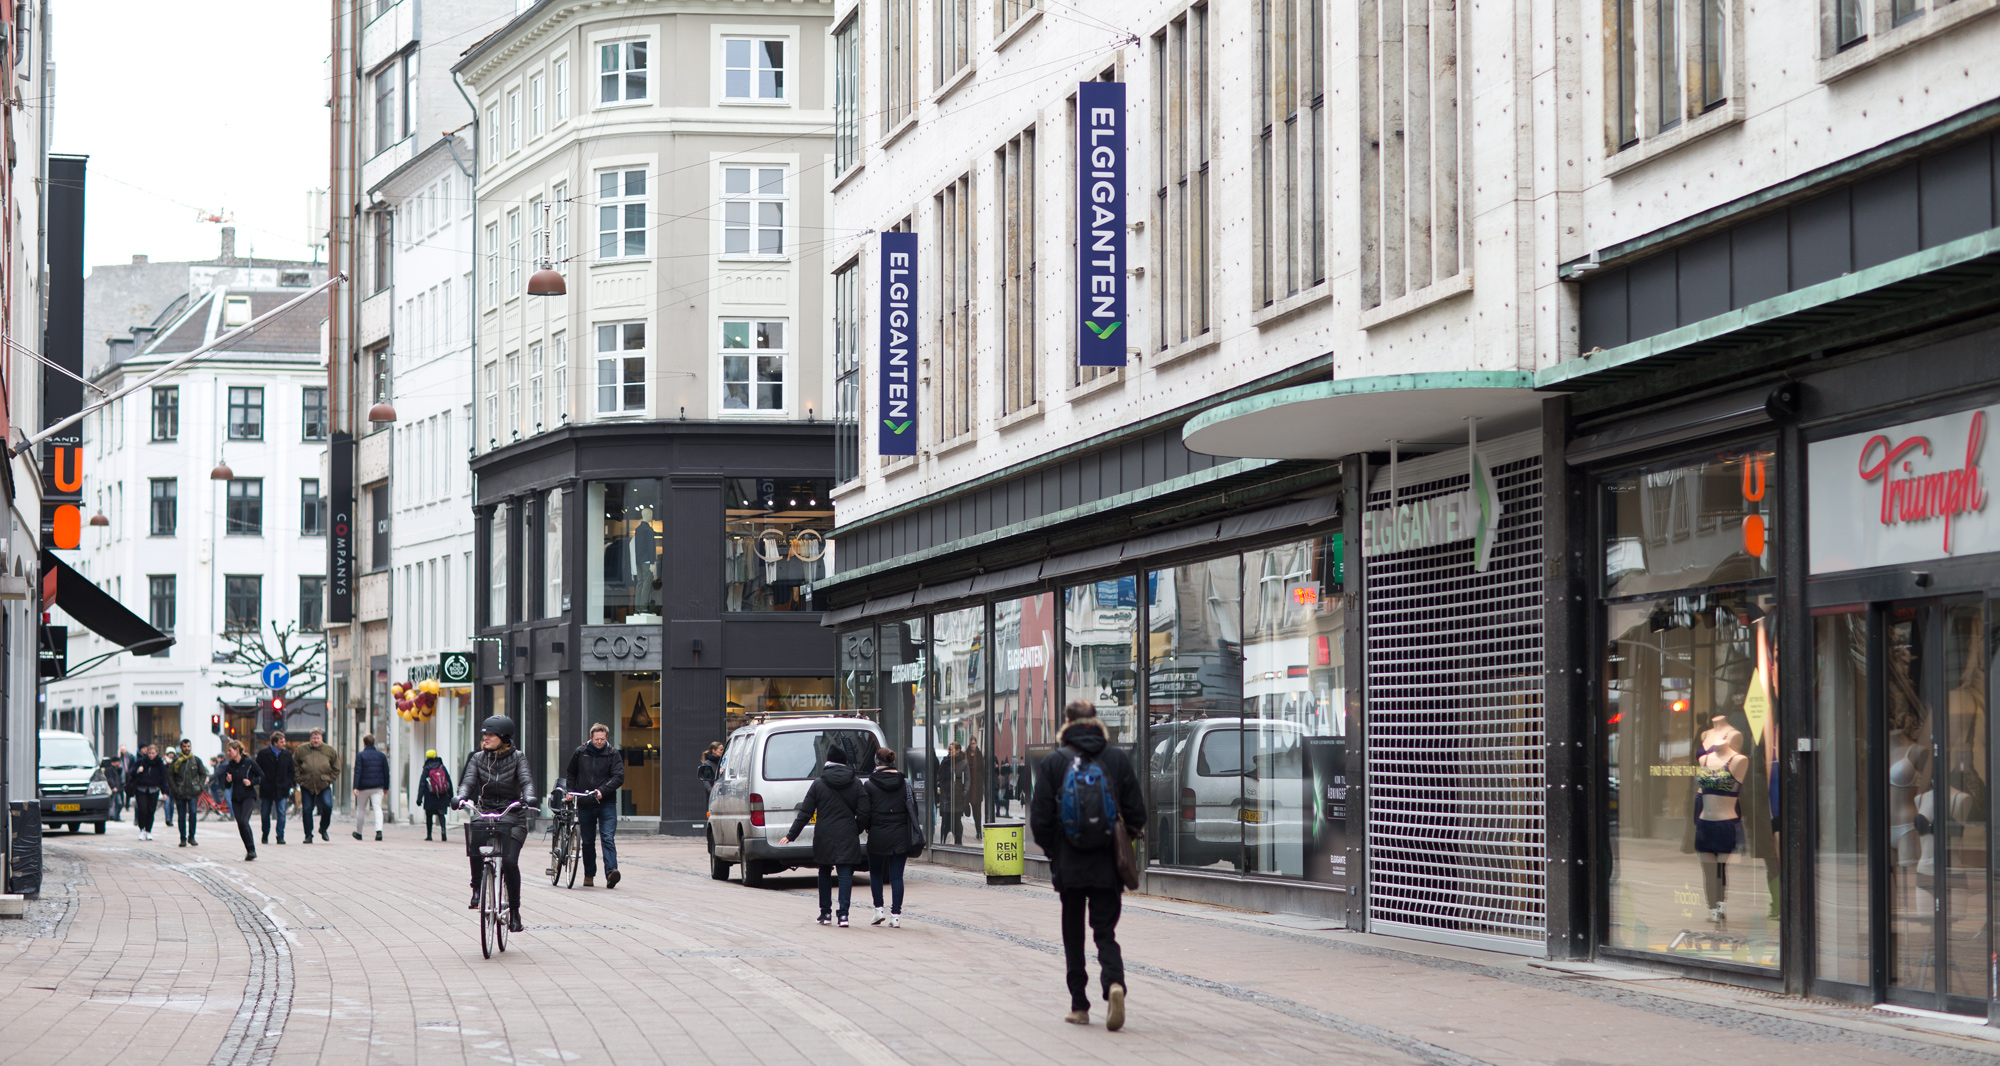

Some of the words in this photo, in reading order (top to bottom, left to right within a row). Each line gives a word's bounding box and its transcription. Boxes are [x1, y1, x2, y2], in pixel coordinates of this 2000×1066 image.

[1091, 107, 1115, 318] ELGIGANTEN
[889, 252, 909, 418] ELGIGANTEN
[1859, 410, 1983, 553] Triumph
[335, 513, 348, 595] COMPANYS
[1362, 488, 1481, 558] ELGIGANTEN
[592, 636, 647, 660] COS
[1007, 645, 1043, 671] ELGIGANTEN
[1259, 688, 1346, 748] ELGIGAN
[996, 842, 1018, 850] REN
[996, 852, 1018, 861] KBH
